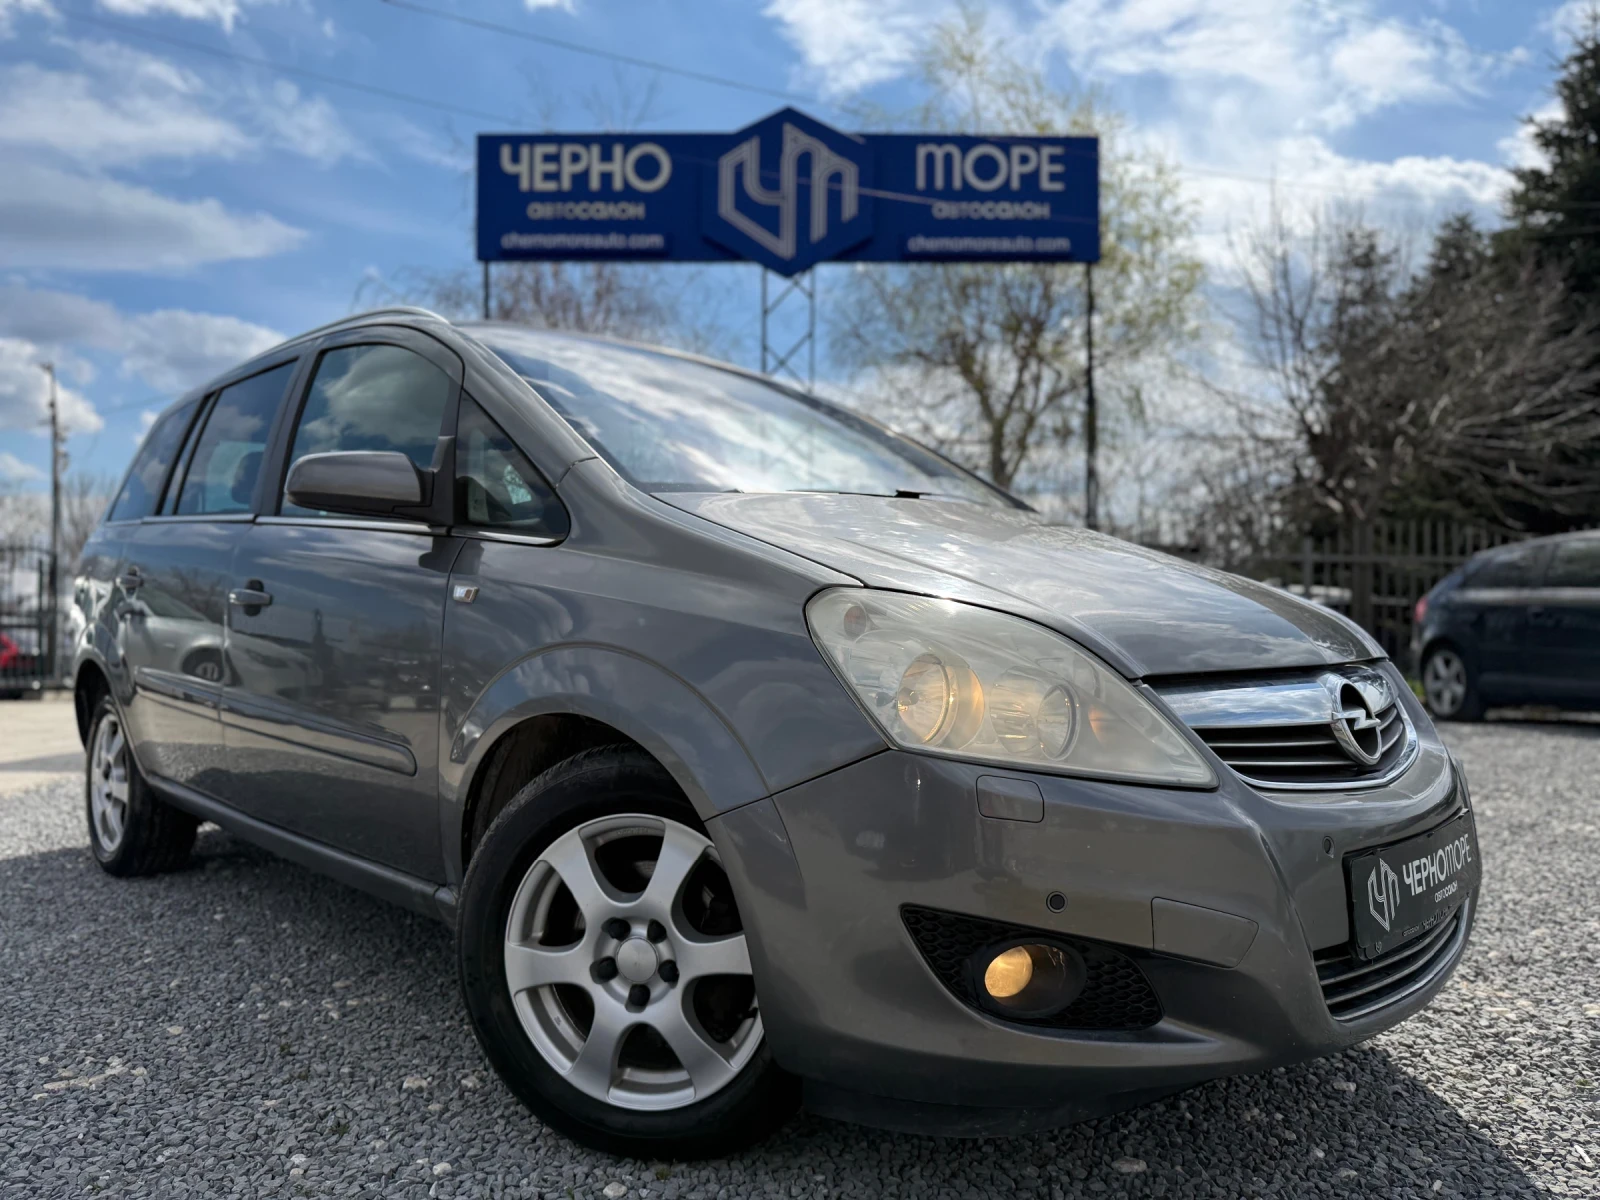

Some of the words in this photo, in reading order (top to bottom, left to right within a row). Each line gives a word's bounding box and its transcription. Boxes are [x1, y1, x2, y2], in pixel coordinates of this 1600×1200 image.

[500, 143, 672, 192] ЧЕРНО
[915, 143, 1065, 191] МОРЕ
[1402, 833, 1471, 896] ЧЕРНОМОРЕ
